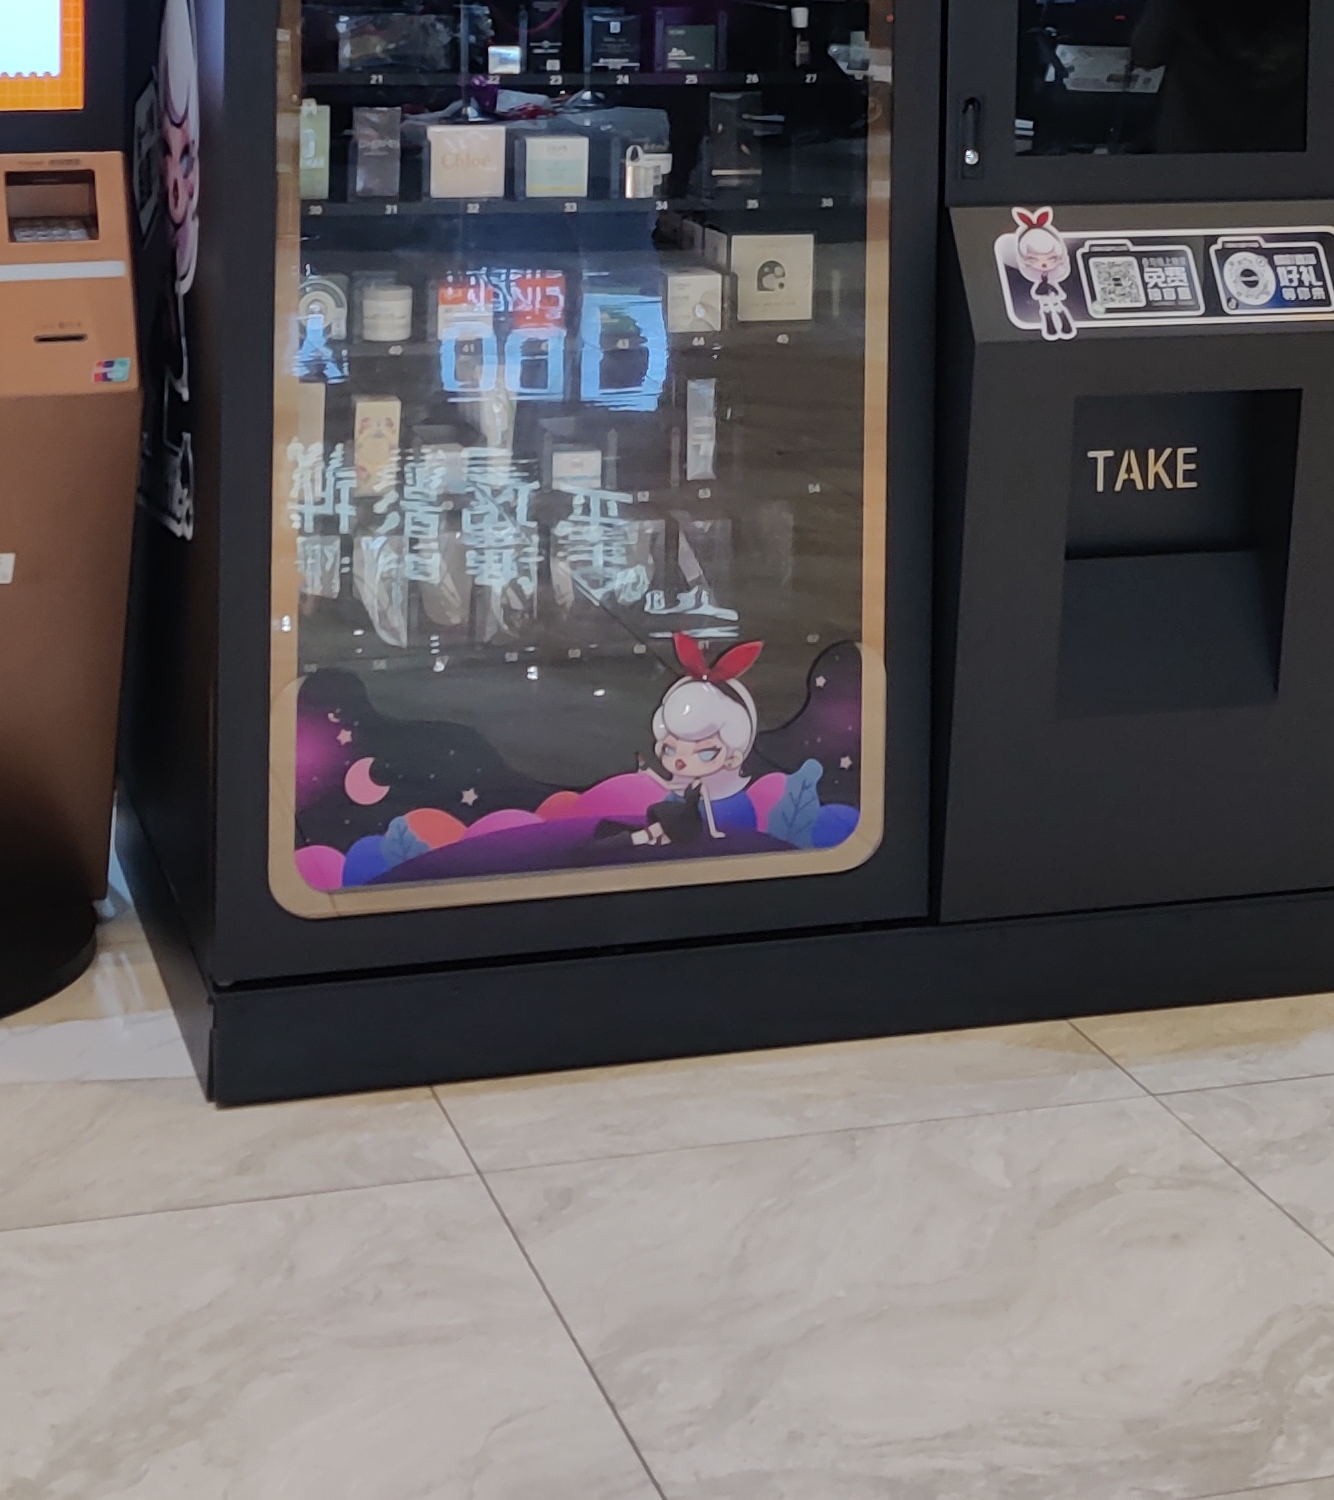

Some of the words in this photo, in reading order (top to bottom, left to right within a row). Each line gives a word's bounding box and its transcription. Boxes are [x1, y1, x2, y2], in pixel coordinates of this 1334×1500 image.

[1144, 267, 1189, 288] 免费
[1276, 265, 1323, 287] 好礼
[1086, 446, 1198, 492] TAKE
